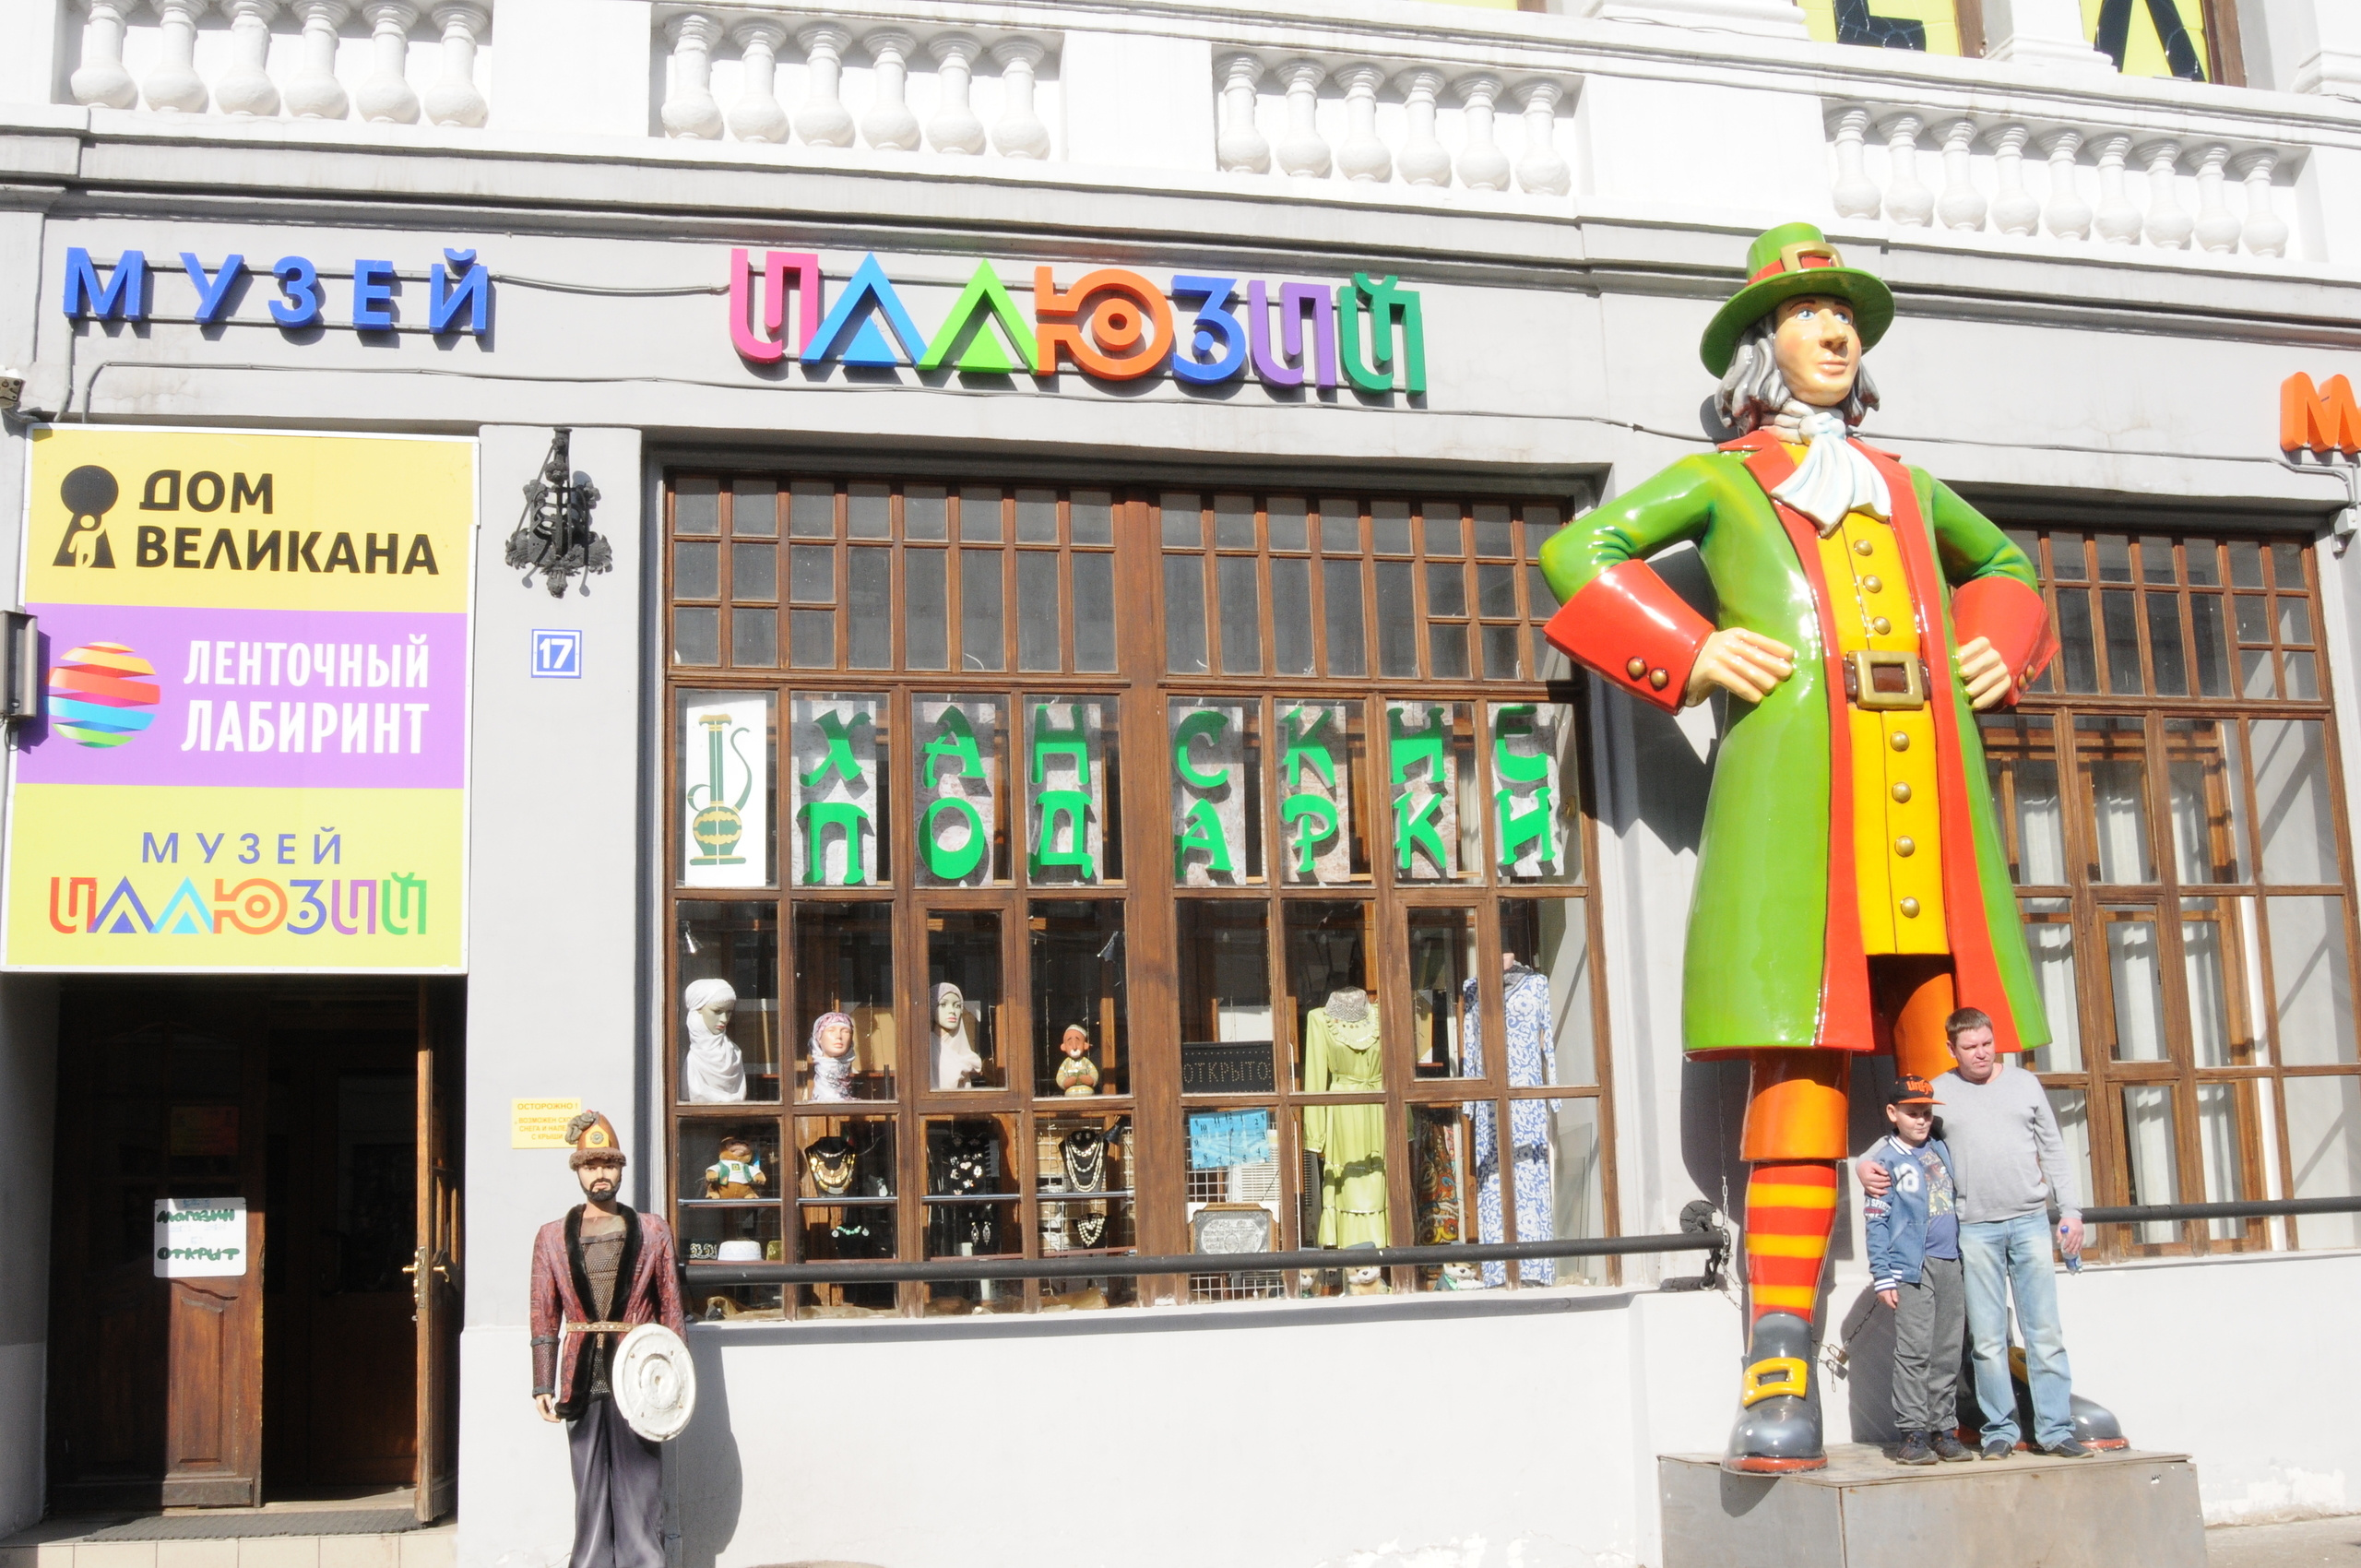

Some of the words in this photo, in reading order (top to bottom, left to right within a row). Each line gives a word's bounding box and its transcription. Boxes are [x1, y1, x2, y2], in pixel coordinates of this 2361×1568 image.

[63, 247, 488, 337] МУЗЕЙ
[730, 247, 1426, 397] ИЛЛЮЗИЙ
[139, 469, 274, 515] ДОМ
[136, 524, 440, 576] ВЕЛИКАНА
[183, 634, 430, 688] ЛЕНТОЧНЫЙ
[540, 637, 574, 670] 17
[181, 700, 431, 754] ЛАБИРИНТ
[799, 705, 1548, 788] ХАНСКИЕ
[142, 826, 342, 865] МУЗЕЙ
[797, 787, 1556, 885] ПОДАРКИ
[49, 872, 428, 935] ИЛЛЮЗИЙ
[1183, 1061, 1268, 1084] ОТКРЫТО
[517, 1102, 574, 1111] ОСТОРОЖНО
